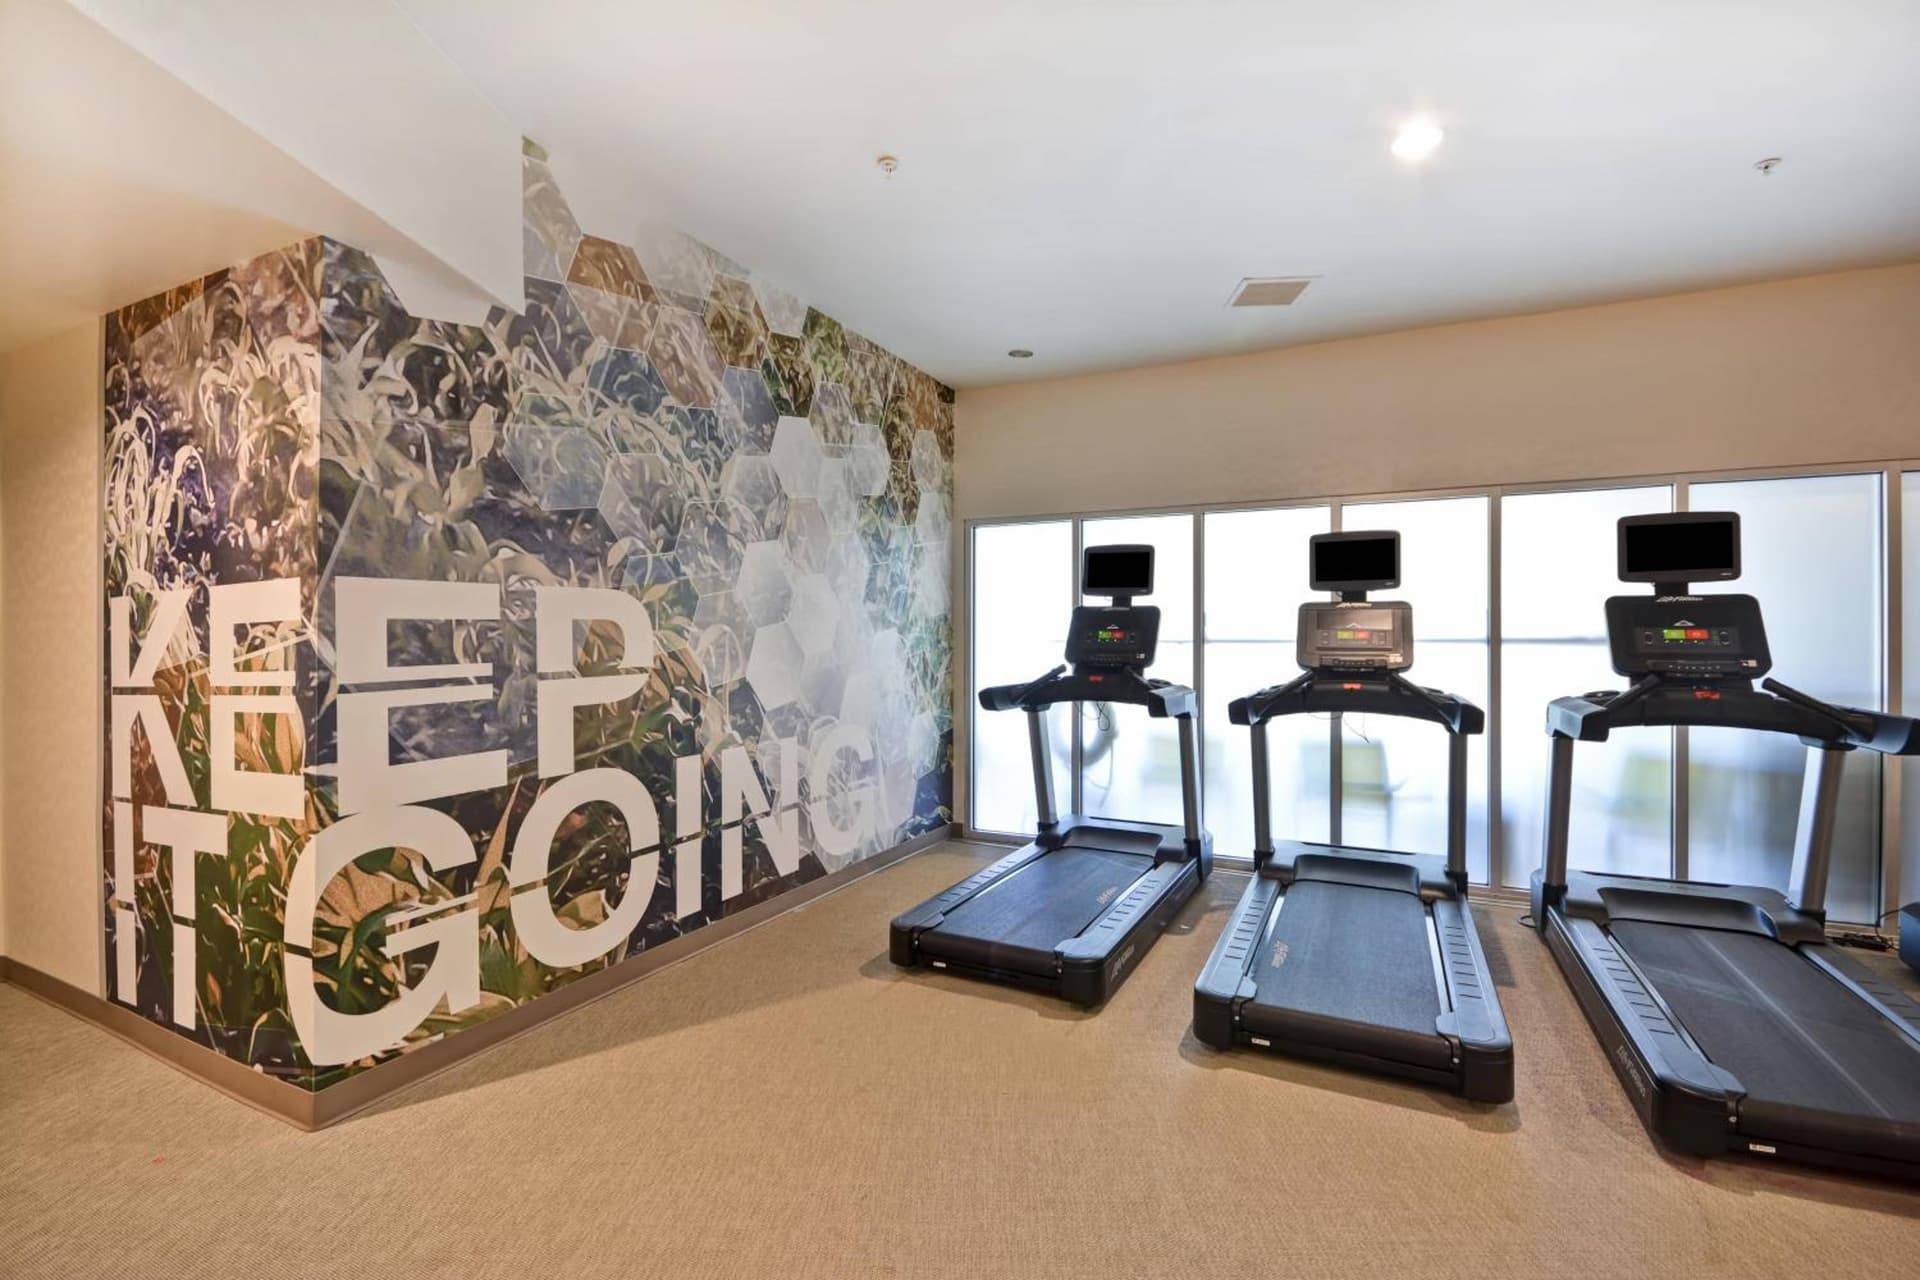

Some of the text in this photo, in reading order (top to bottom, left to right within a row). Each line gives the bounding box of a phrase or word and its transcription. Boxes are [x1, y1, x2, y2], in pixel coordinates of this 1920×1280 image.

[111, 576, 655, 819] KEEP
[113, 723, 877, 1066] IT GOING
